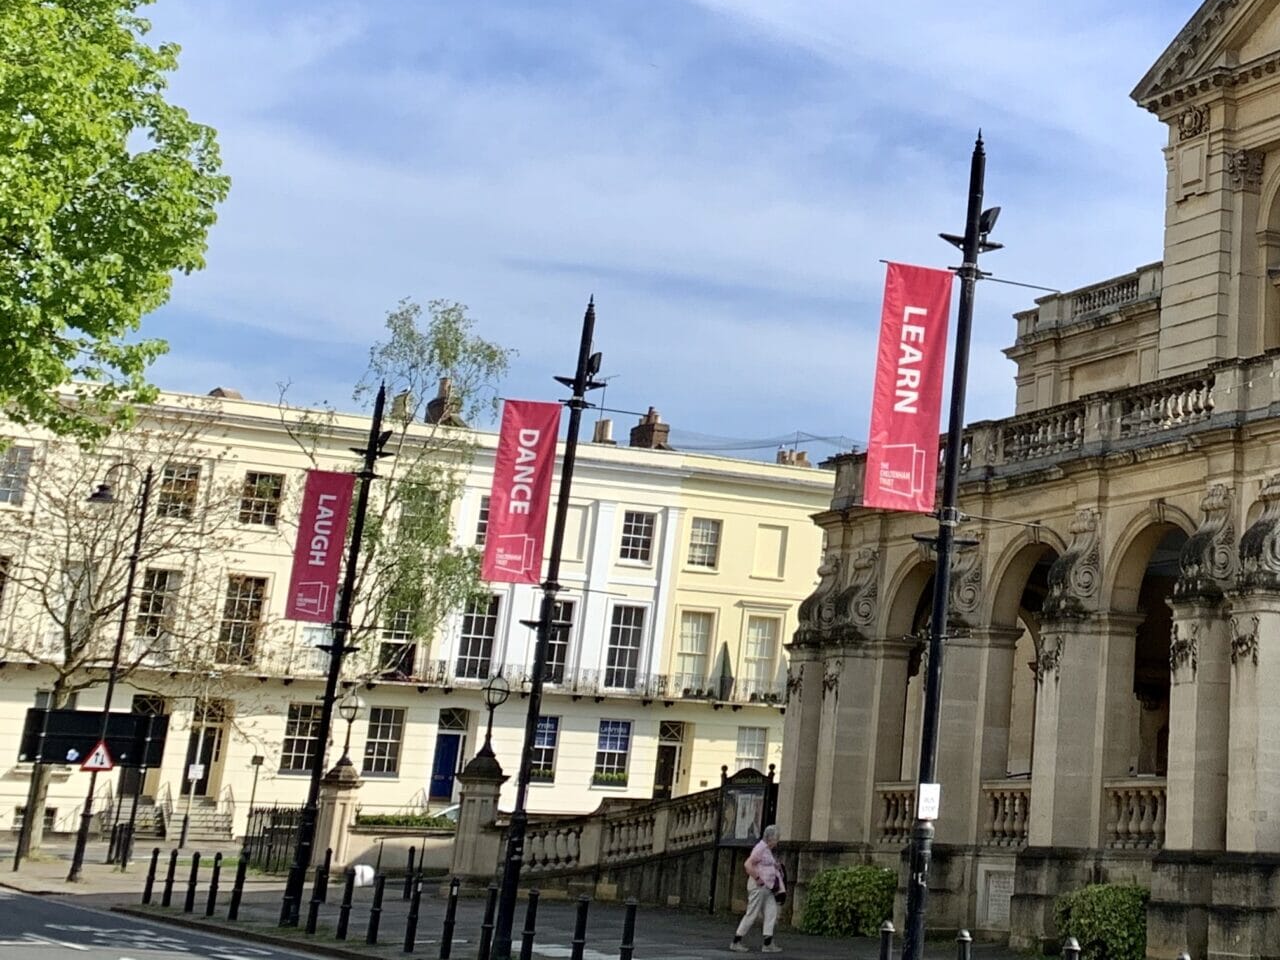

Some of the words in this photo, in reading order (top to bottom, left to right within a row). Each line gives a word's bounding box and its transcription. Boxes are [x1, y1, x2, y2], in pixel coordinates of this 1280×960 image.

[893, 305, 928, 414] LEARN
[509, 428, 540, 515] DANCE
[308, 494, 337, 566] LAUGH
